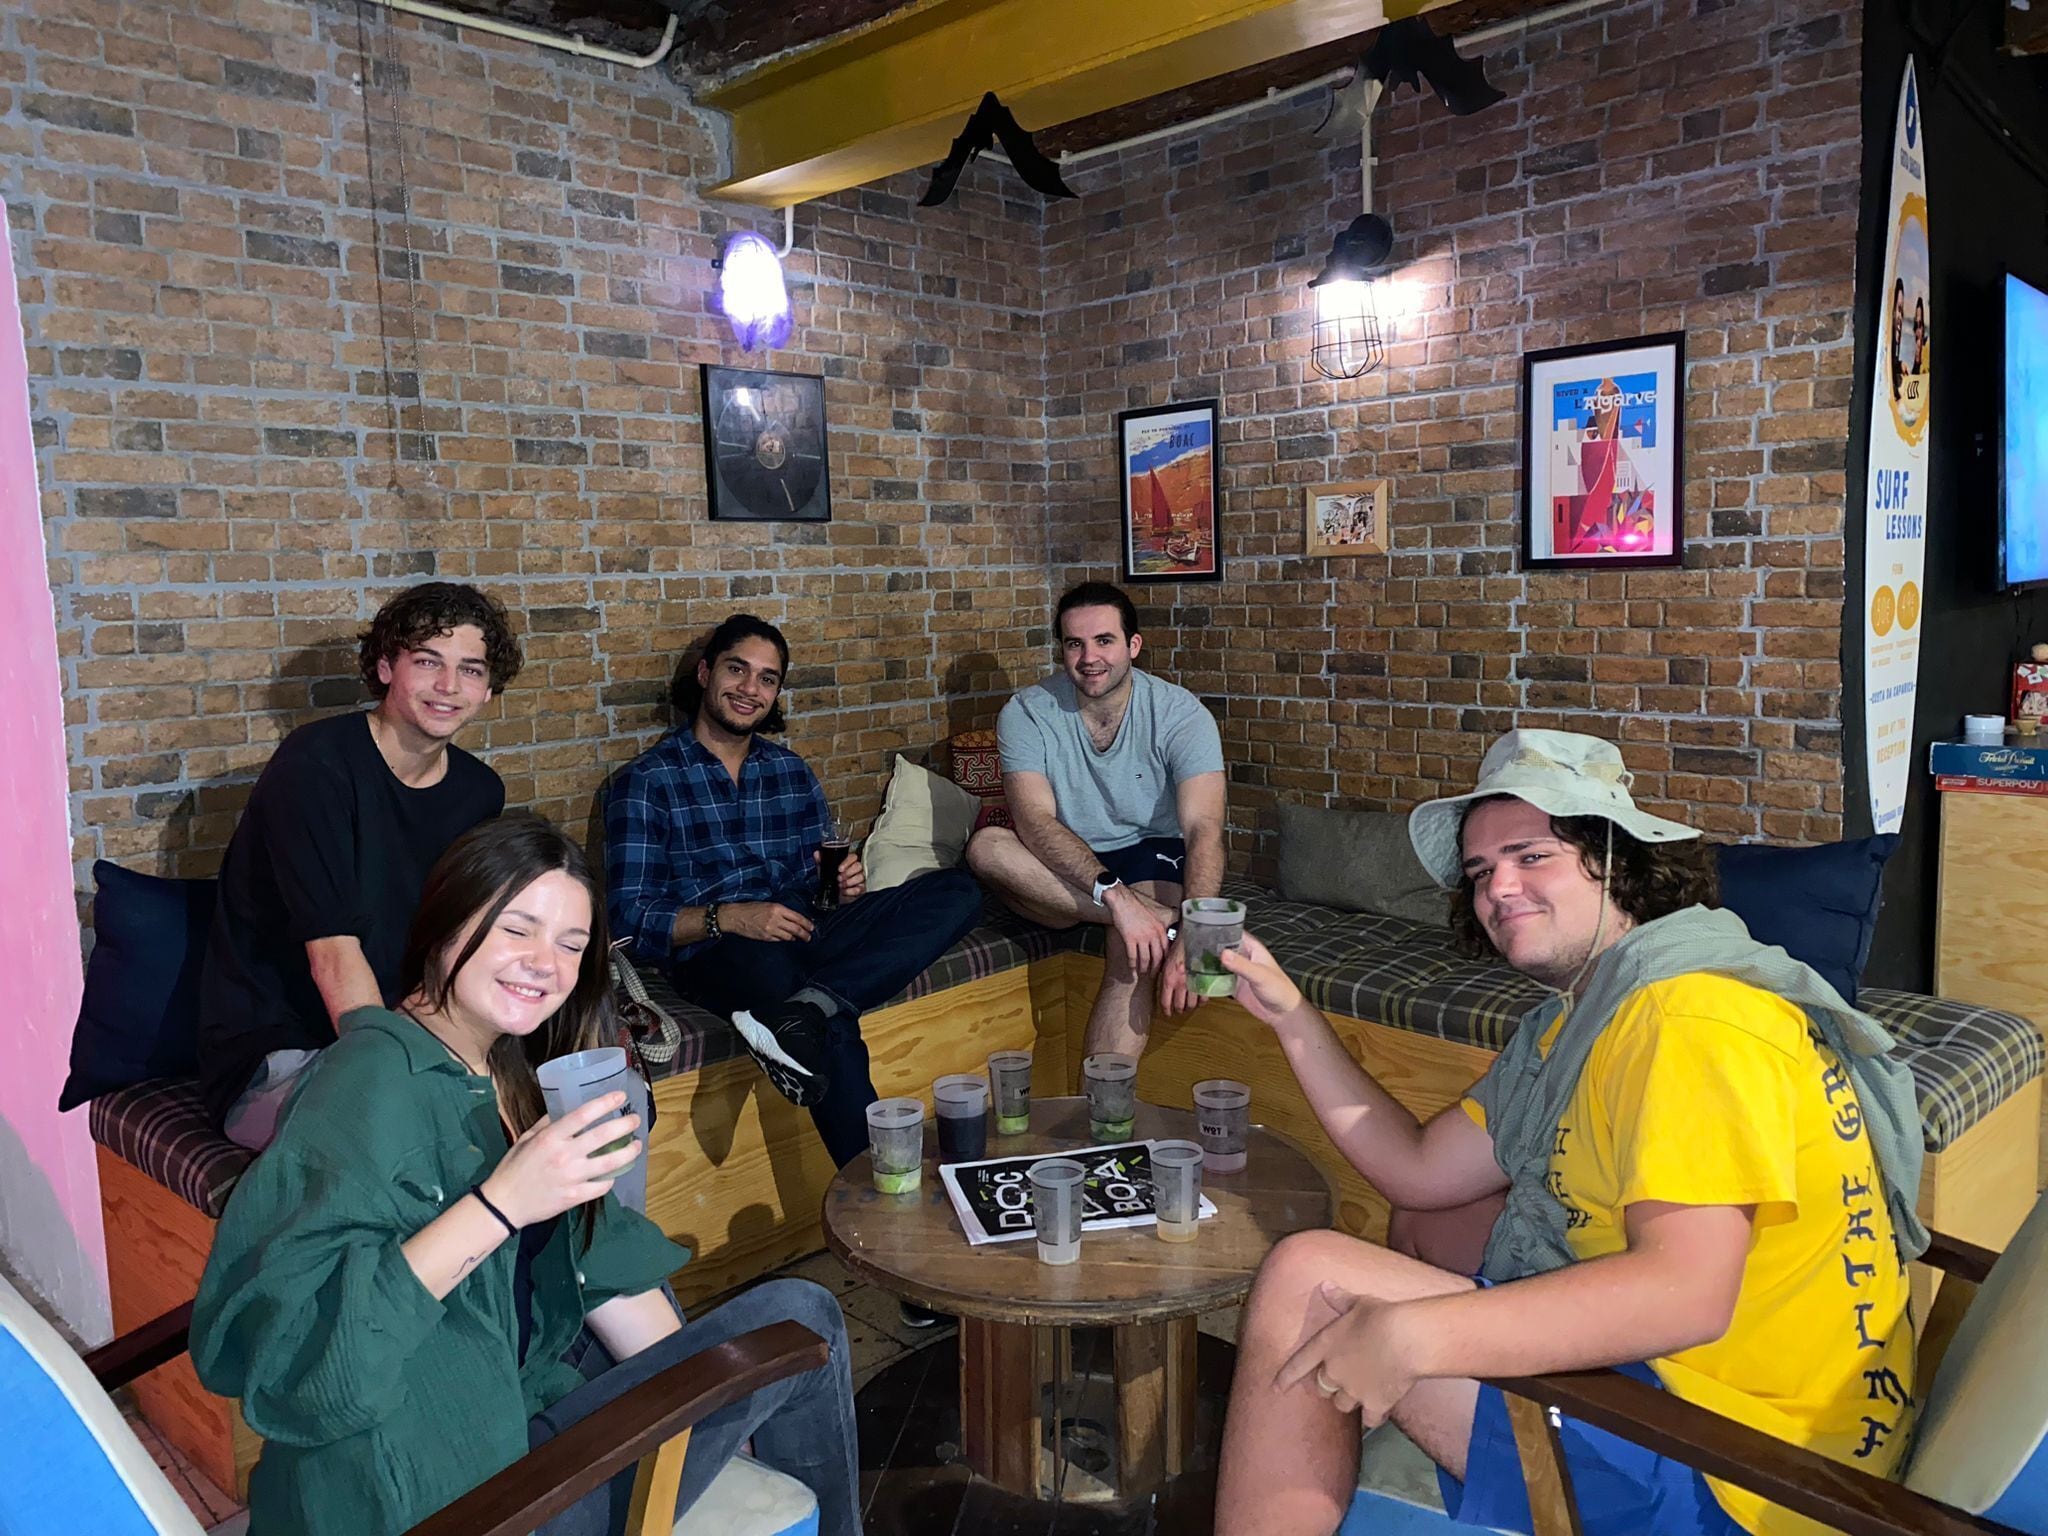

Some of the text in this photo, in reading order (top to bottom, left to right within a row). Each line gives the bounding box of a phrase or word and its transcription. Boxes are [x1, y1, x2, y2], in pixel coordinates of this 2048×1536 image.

[1169, 432, 1194, 449] BOAC
[1875, 469, 1909, 510] SURF
[1886, 514, 1922, 540] LESSONS
[1977, 778, 2040, 789] SUPERPOLY
[993, 1170, 1033, 1228] DOC
[1094, 1158, 1147, 1213] BOA
